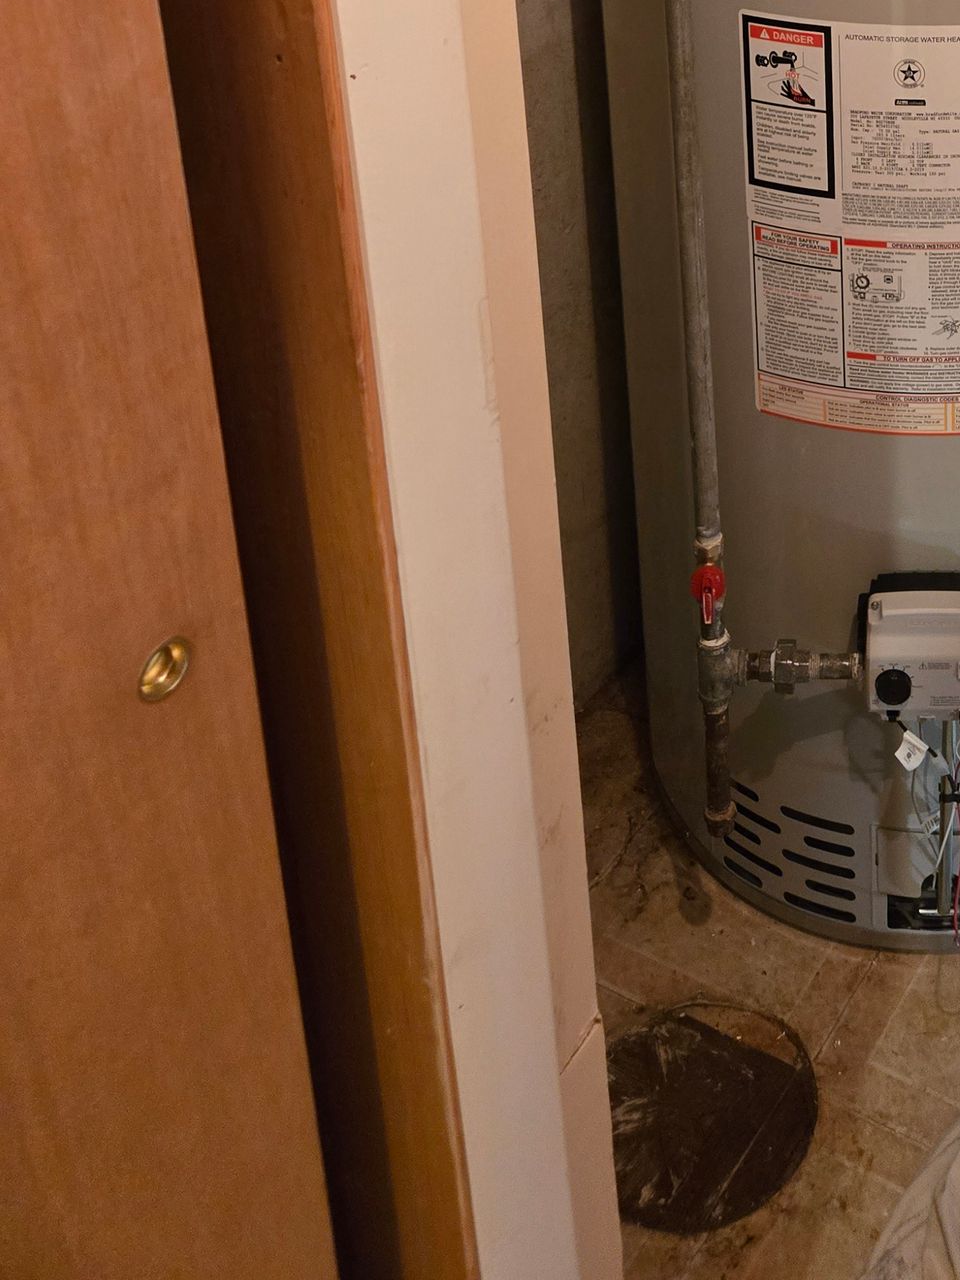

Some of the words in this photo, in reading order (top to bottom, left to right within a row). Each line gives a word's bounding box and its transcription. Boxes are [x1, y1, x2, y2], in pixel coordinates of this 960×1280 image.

[773, 31, 814, 45] DANGER
[845, 34, 884, 42] AUTOMATIC
[785, 71, 799, 79] HOT
[777, 238, 797, 246] BEFORE
[798, 237, 819, 245] SAFETY
[876, 394, 901, 402] CONTROL
